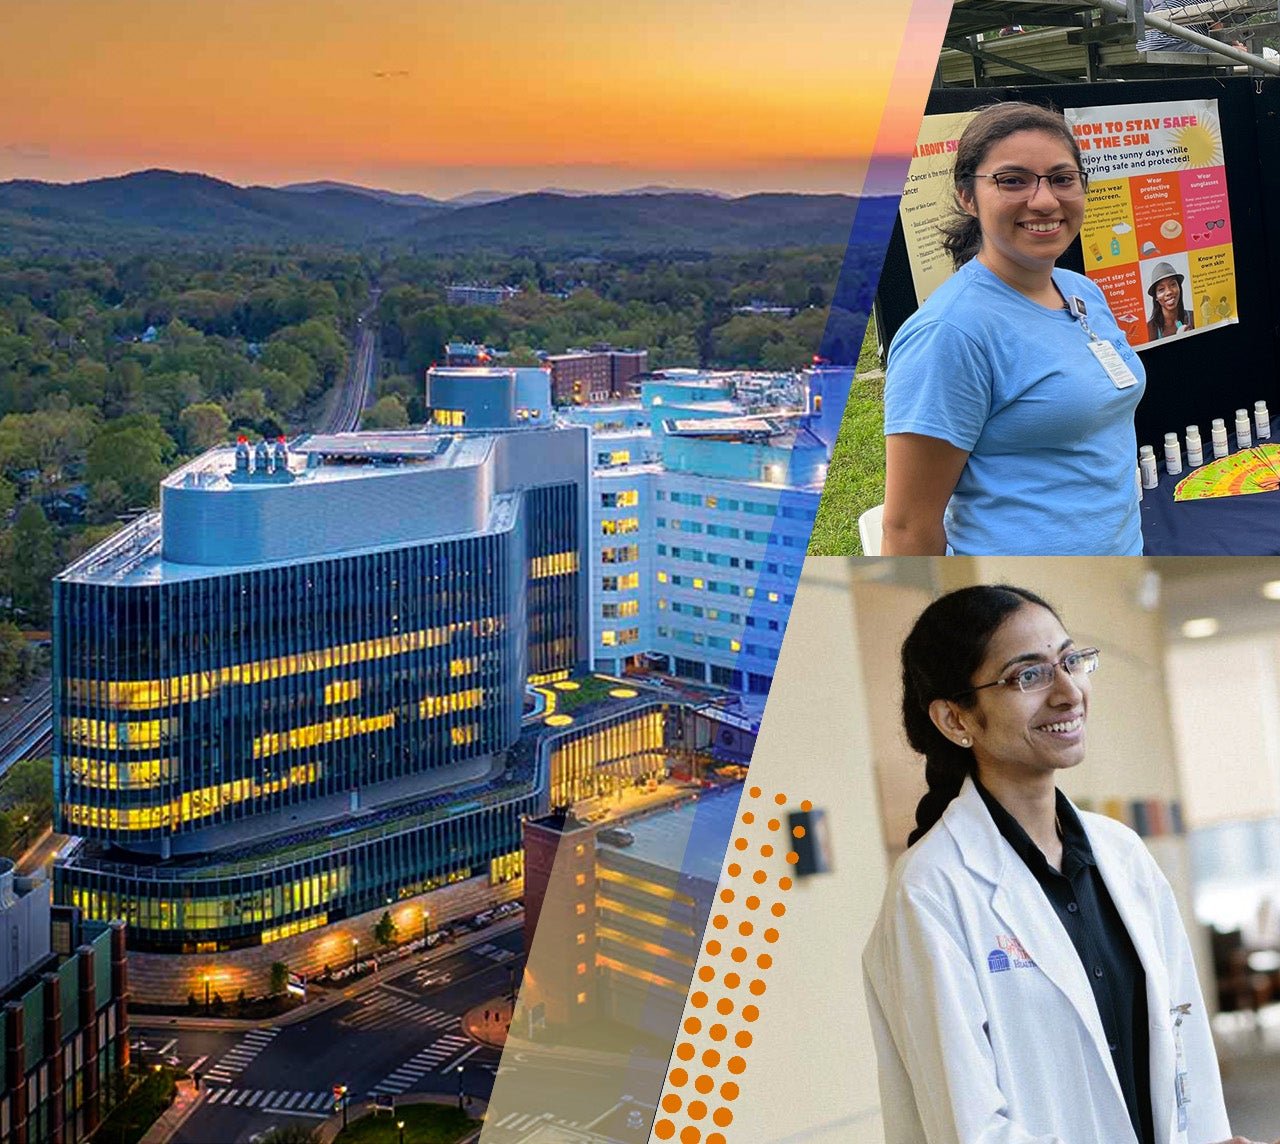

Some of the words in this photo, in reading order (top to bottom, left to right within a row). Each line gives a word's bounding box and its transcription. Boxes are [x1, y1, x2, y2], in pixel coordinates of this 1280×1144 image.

[1072, 123, 1102, 136] HOW
[1105, 122, 1123, 133] TO
[1126, 118, 1160, 132] STAY
[1163, 116, 1197, 128] SAFE
[1093, 136, 1120, 149] THE
[1124, 134, 1149, 146] SUN
[920, 142, 945, 157] ABOUT
[1082, 154, 1101, 165] njoy
[1104, 153, 1117, 161] the
[1120, 151, 1143, 162] sunny
[1146, 147, 1164, 157] days
[1167, 146, 1188, 155] while
[1087, 165, 1110, 174] aying
[1113, 161, 1128, 171] safe
[1131, 160, 1146, 168] and
[1148, 155, 1190, 167] protected!
[911, 173, 927, 182] Cancer
[1140, 184, 1170, 193] protective
[1191, 180, 1218, 189] sunglasses
[1088, 194, 1120, 202] sunscreen.
[1144, 192, 1168, 200] clothing
[1198, 255, 1213, 263] Know
[1215, 253, 1226, 261] your
[1213, 259, 1224, 267] skin
[1112, 273, 1124, 282] stay
[1114, 281, 1125, 289] sun
[1110, 289, 1124, 297] long
